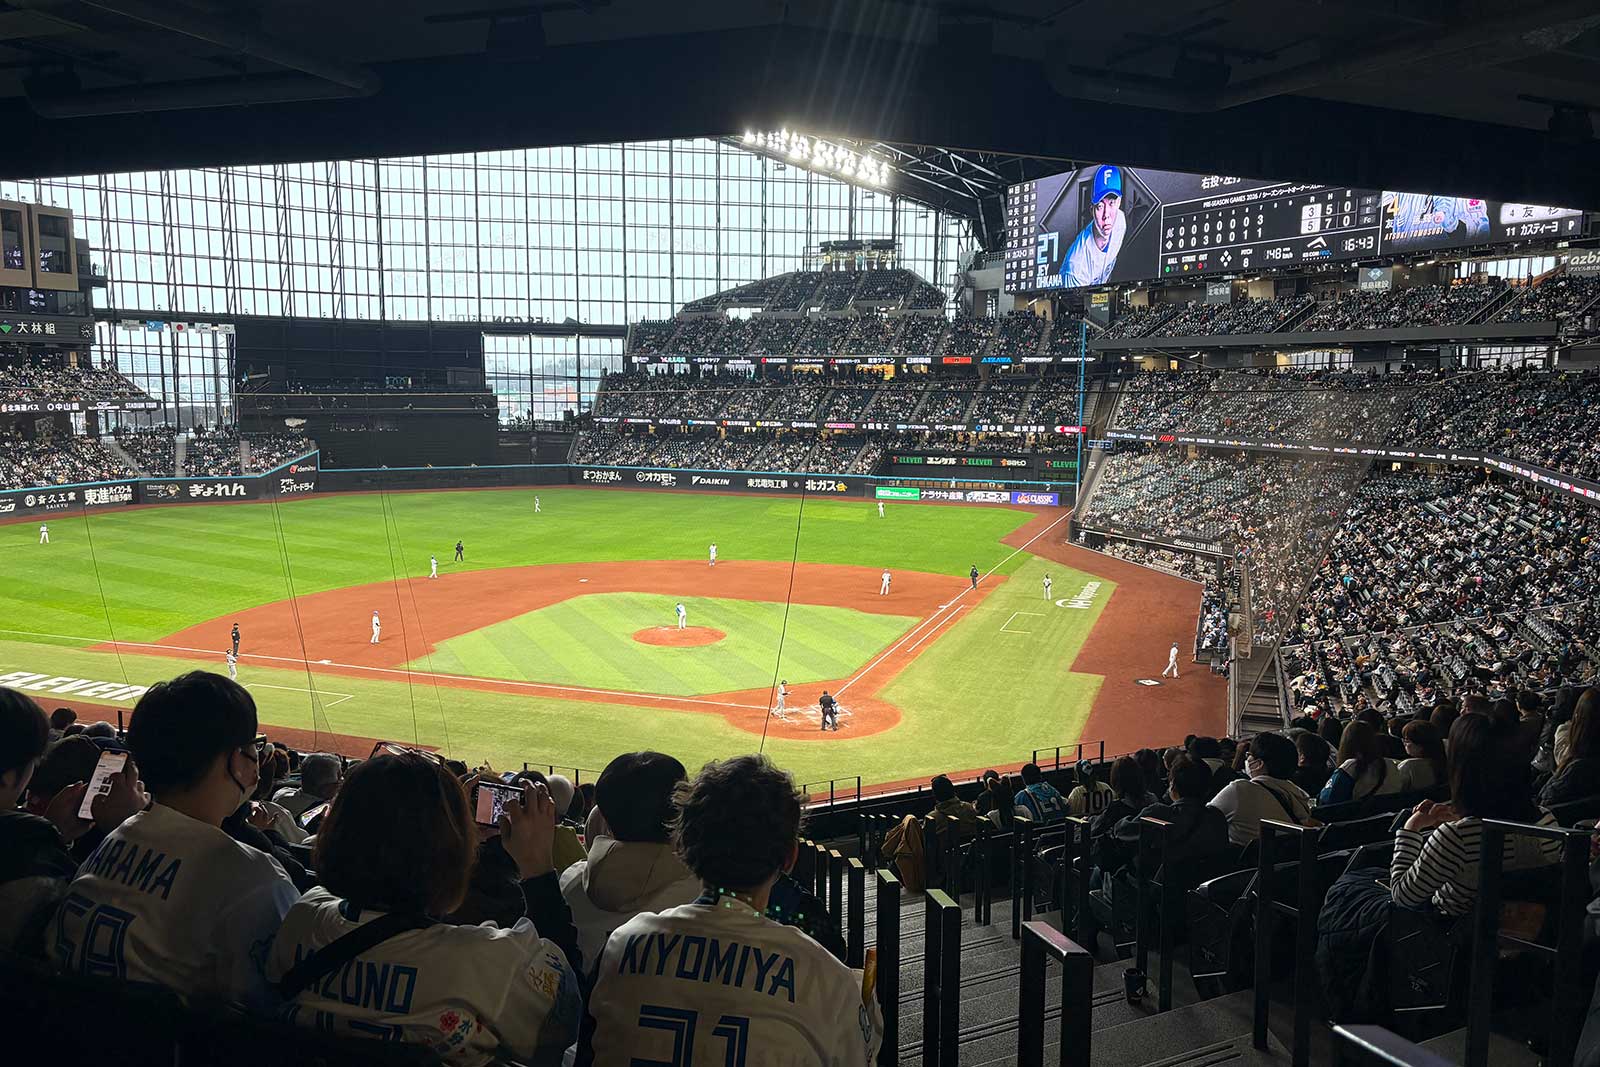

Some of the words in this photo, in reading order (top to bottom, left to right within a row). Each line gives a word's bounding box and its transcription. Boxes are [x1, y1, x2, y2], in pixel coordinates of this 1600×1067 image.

[1104, 169, 1113, 185] F
[1328, 193, 1334, 201] H
[1346, 190, 1352, 198] E
[1386, 194, 1400, 215] 4
[1179, 226, 1185, 237] 0
[1191, 224, 1197, 235] 0
[1204, 222, 1210, 233] 0
[1216, 220, 1223, 231] 0
[1230, 219, 1236, 229] 0
[1243, 217, 1250, 227] 0
[1257, 214, 1264, 225] 3
[1308, 207, 1315, 218] 3
[1326, 204, 1333, 215] 5
[1344, 201, 1352, 212] 0
[1179, 238, 1185, 249] 0
[1191, 236, 1197, 247] 0
[1203, 235, 1209, 245] 3
[1216, 233, 1222, 244] 0
[1229, 231, 1236, 242] 0
[1243, 229, 1248, 240] 1
[1257, 227, 1262, 238] 1
[1308, 221, 1314, 231] 5
[1325, 218, 1332, 229] 7
[1343, 216, 1350, 227] 0
[1506, 227, 1516, 237] 11
[1520, 221, 1559, 236] カスティーヨ
[1568, 220, 1575, 231] P
[1037, 232, 1059, 264] 27
[1344, 236, 1374, 251] 16:43
[1243, 257, 1249, 268] 8
[1266, 248, 1282, 260] 148
[17, 322, 56, 335] 大林組
[583, 470, 622, 481] まつおかまん
[645, 472, 677, 482] オカモト
[109, 485, 132, 495] ハイスクール
[189, 483, 247, 497] ぎょれん
[281, 482, 315, 494] スーパードライ
[805, 480, 837, 491] 北ガス
[84, 488, 110, 506] 東進
[920, 491, 964, 500] ナラサキ産業
[1174, 539, 1195, 548] docomo
[618, 933, 795, 1003] KIYOMIYA
